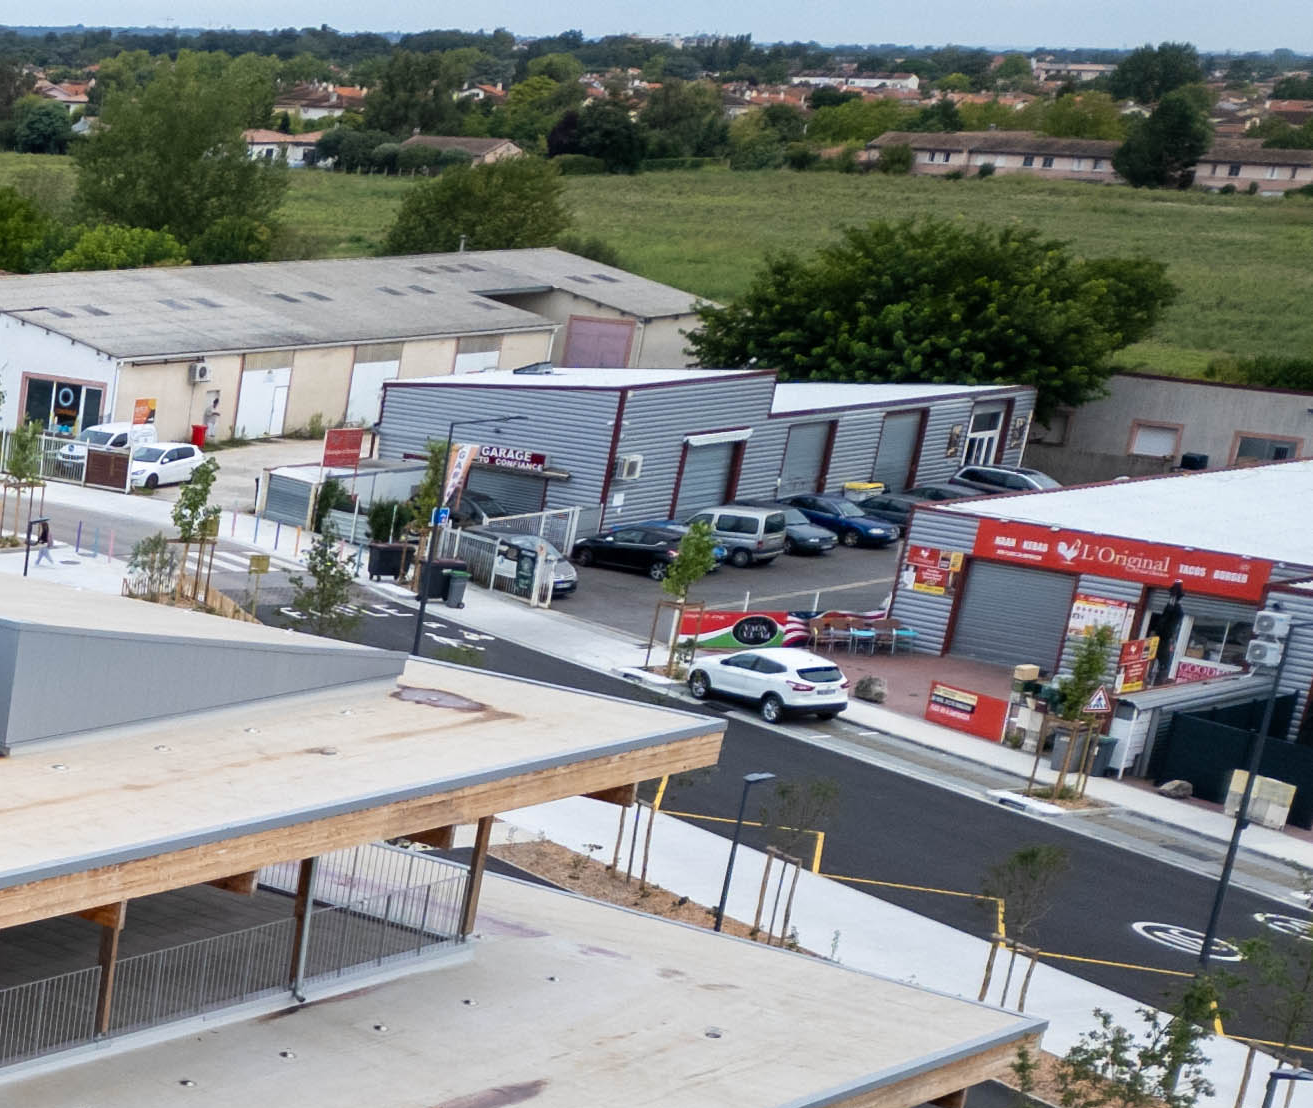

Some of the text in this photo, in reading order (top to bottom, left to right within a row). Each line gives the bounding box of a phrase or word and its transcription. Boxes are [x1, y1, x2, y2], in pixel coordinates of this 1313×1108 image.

[481, 446, 532, 462] GARAGE
[495, 458, 544, 472] CONFIANCE
[1081, 543, 1171, 572] L'Original
